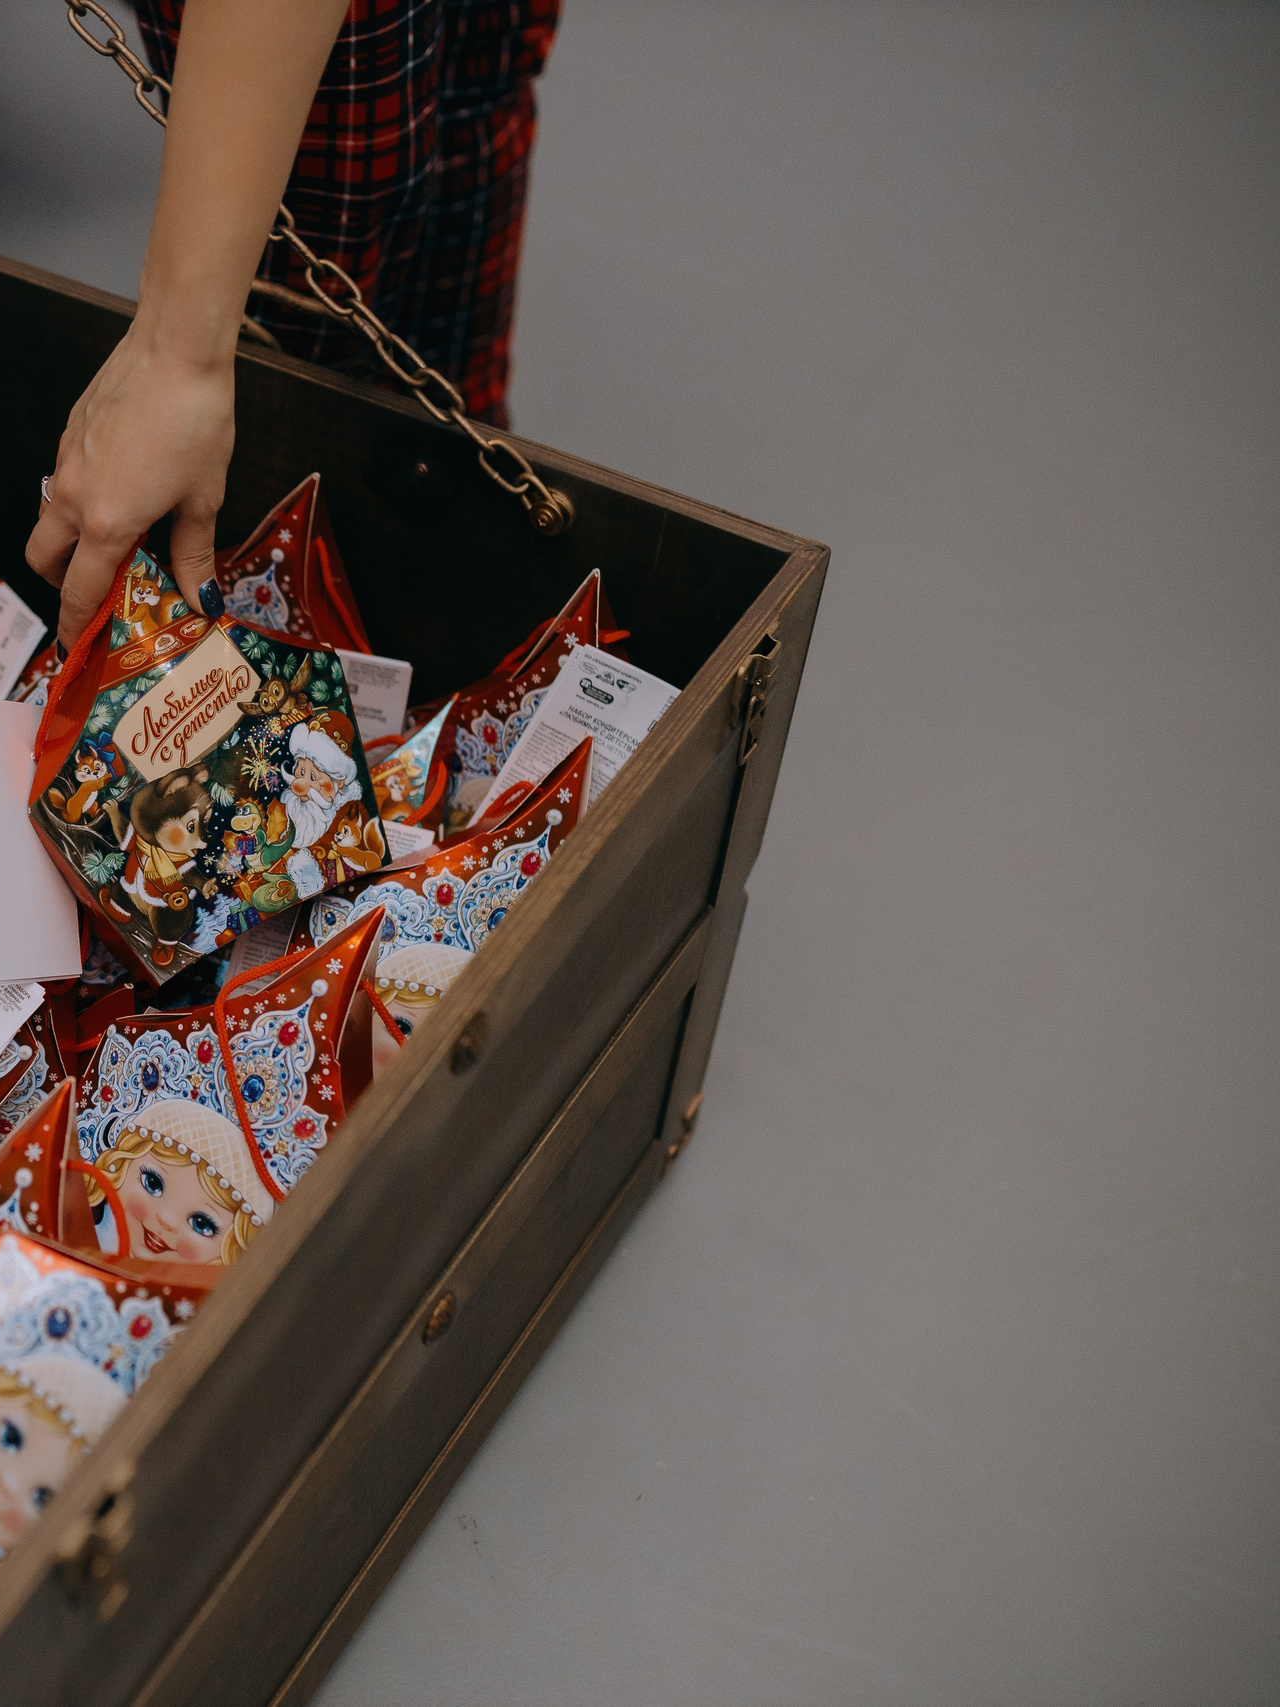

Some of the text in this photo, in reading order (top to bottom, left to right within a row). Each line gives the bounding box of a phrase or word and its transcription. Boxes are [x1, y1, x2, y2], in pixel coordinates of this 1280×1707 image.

[131, 667, 224, 756] Любимые
[160, 664, 251, 768] с детства
[567, 705, 593, 721] НАБОР
